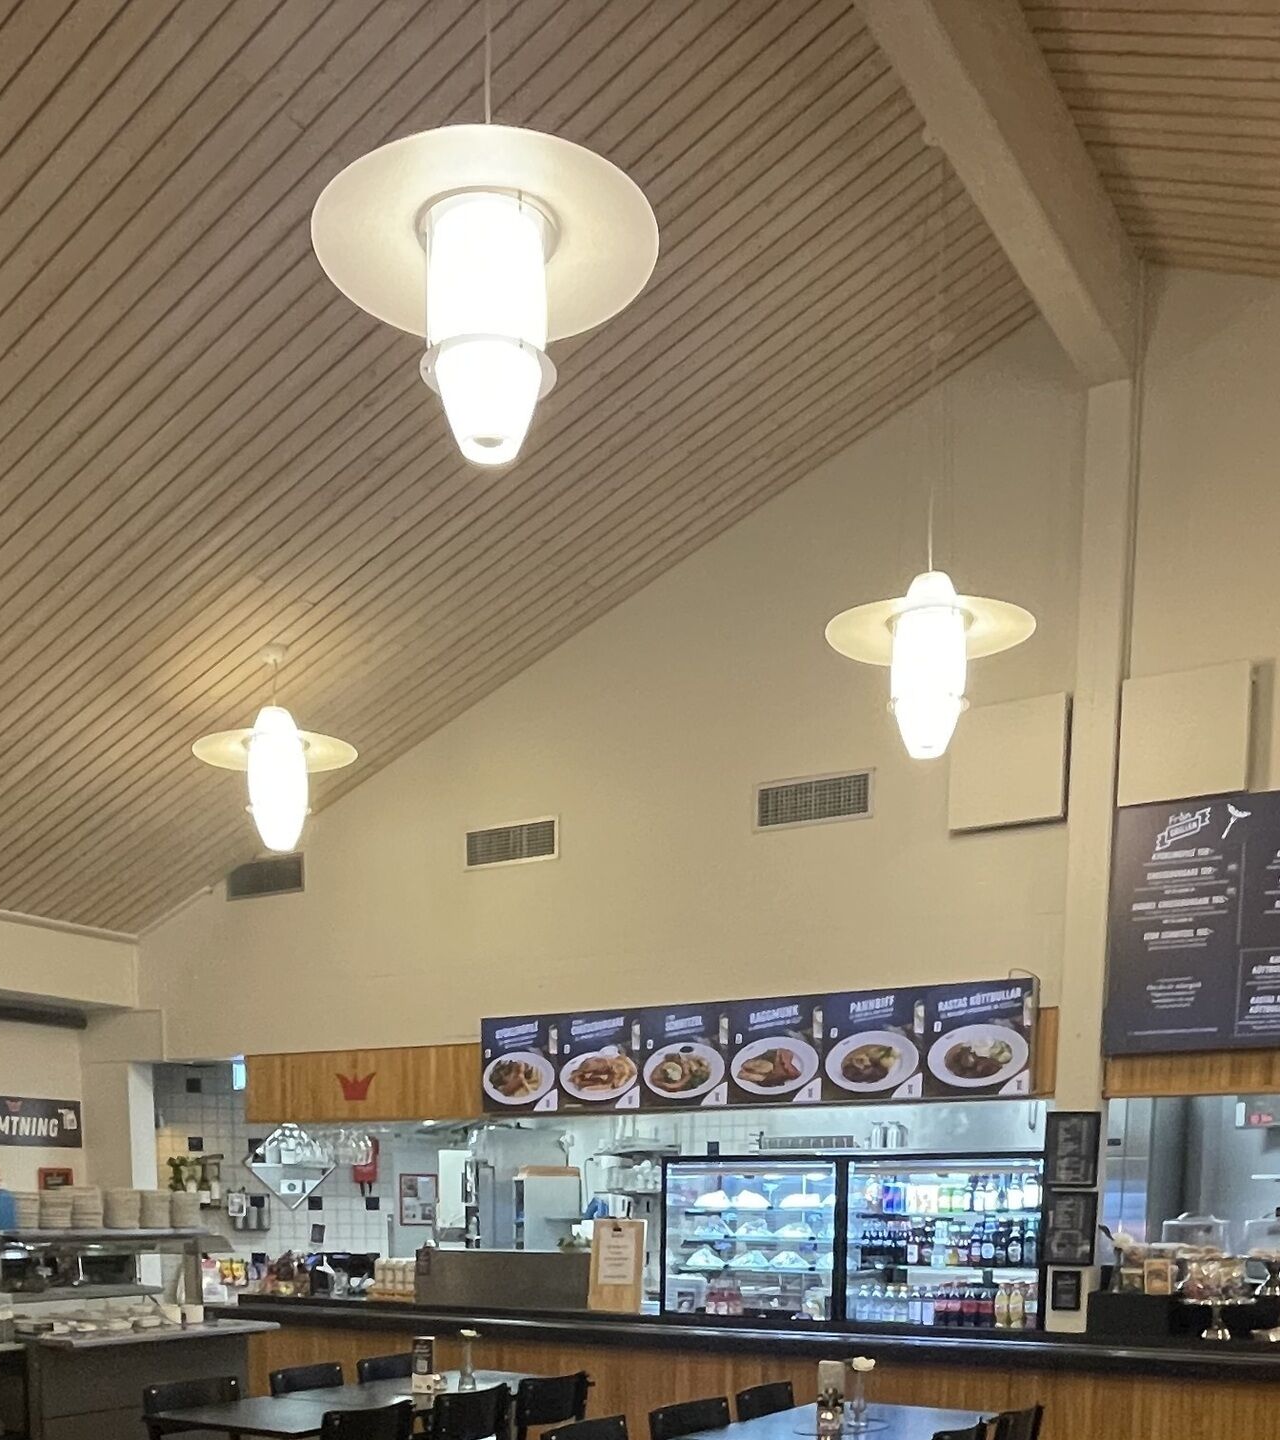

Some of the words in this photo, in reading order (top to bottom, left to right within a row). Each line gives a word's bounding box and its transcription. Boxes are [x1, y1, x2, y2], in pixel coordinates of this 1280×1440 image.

[849, 994, 895, 1014] PANNBIFF
[937, 996, 968, 1012] RASTAS
[969, 986, 1022, 1007] KÖTTBULLAR
